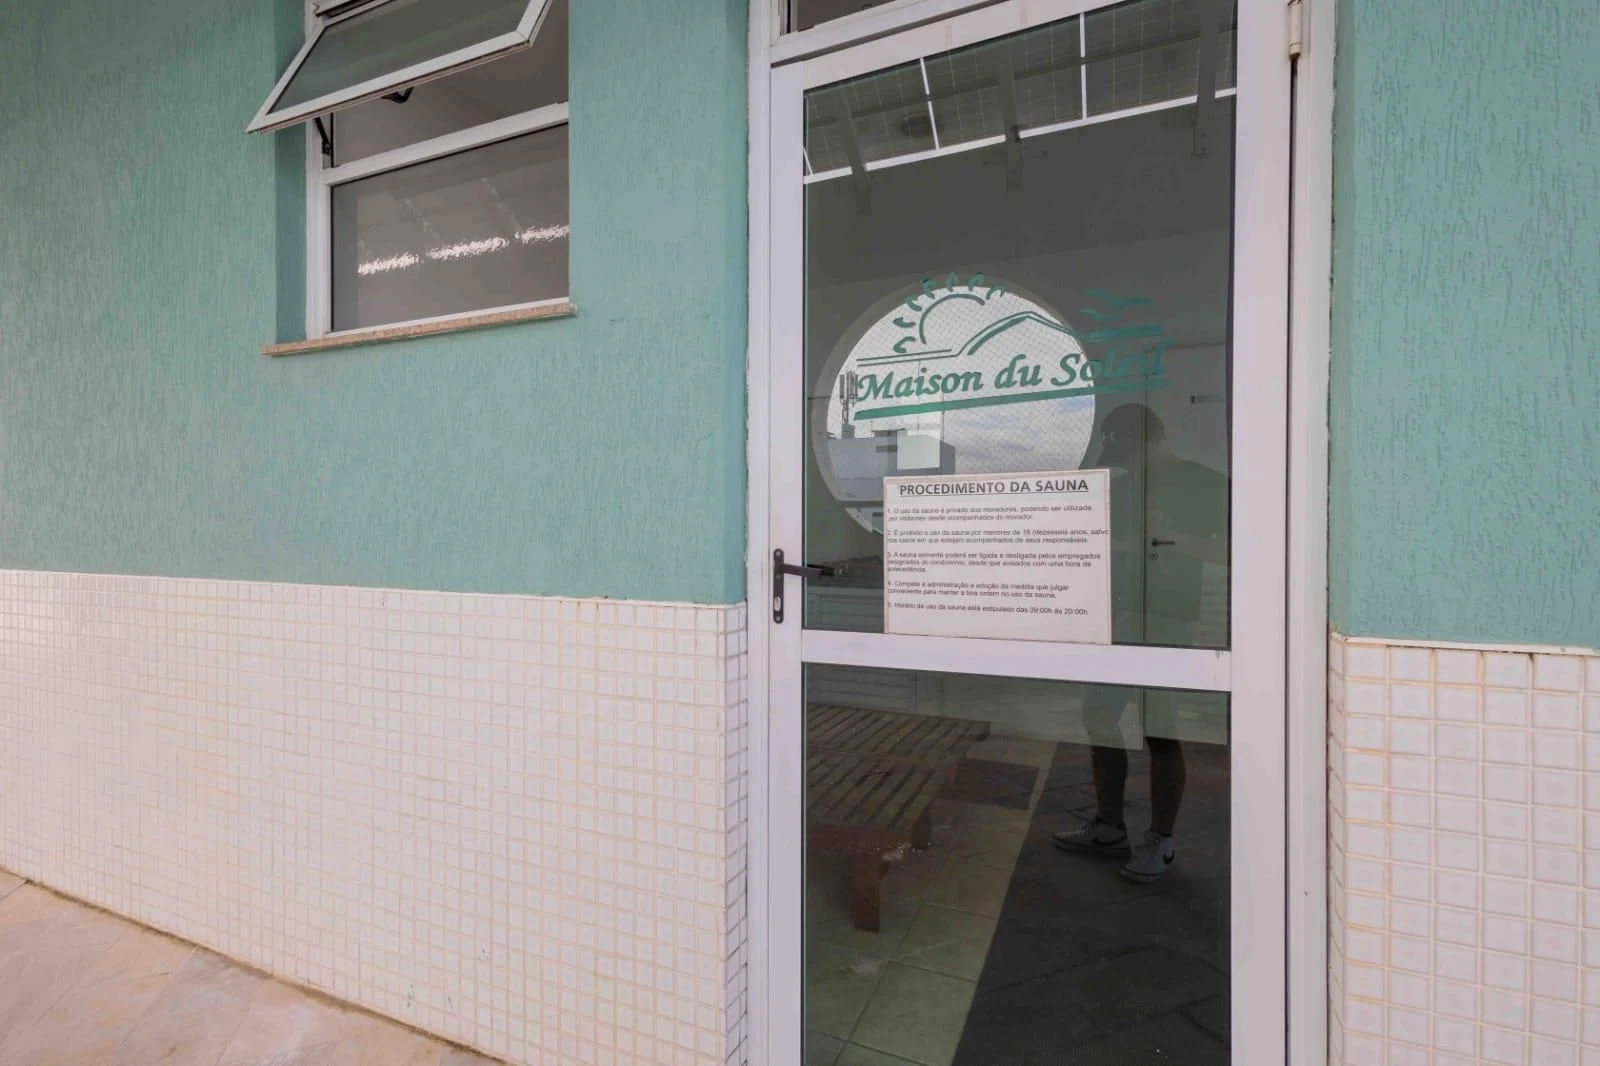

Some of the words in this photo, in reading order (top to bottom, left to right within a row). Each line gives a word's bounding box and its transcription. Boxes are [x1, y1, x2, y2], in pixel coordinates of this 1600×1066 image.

[856, 368, 984, 402] Maison
[995, 354, 1042, 389] du
[1052, 337, 1173, 387] Soleil
[900, 481, 1005, 495] PROCEDIMENTO
[1010, 481, 1030, 492] DA
[1036, 480, 1088, 492] SAUNA
